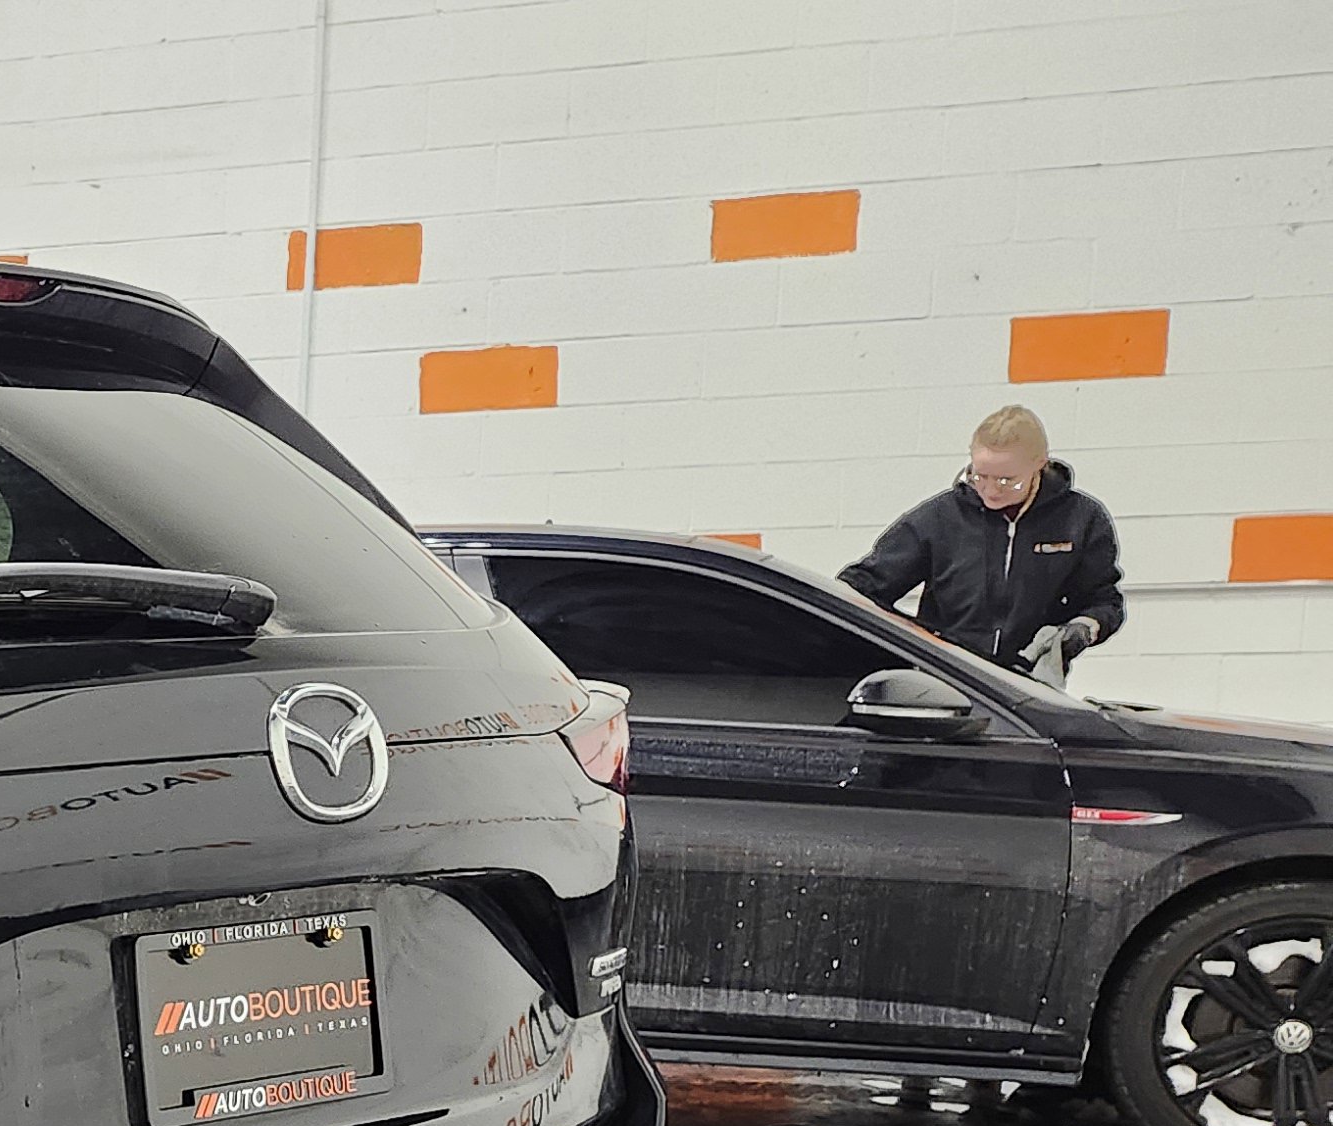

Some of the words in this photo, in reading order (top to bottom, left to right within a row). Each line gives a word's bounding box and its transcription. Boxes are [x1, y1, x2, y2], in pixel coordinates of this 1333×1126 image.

[170, 930, 207, 947] OHIO
[223, 920, 289, 941] FLORIDA
[303, 913, 348, 931] TEXAS
[178, 978, 373, 1033] AUTOBOUTIQUE
[161, 1039, 203, 1056] OHIO
[222, 1026, 296, 1047] FLORIDA
[316, 1016, 369, 1033] TEXAS
[214, 1071, 358, 1115] AUTOBOUTIQUE
